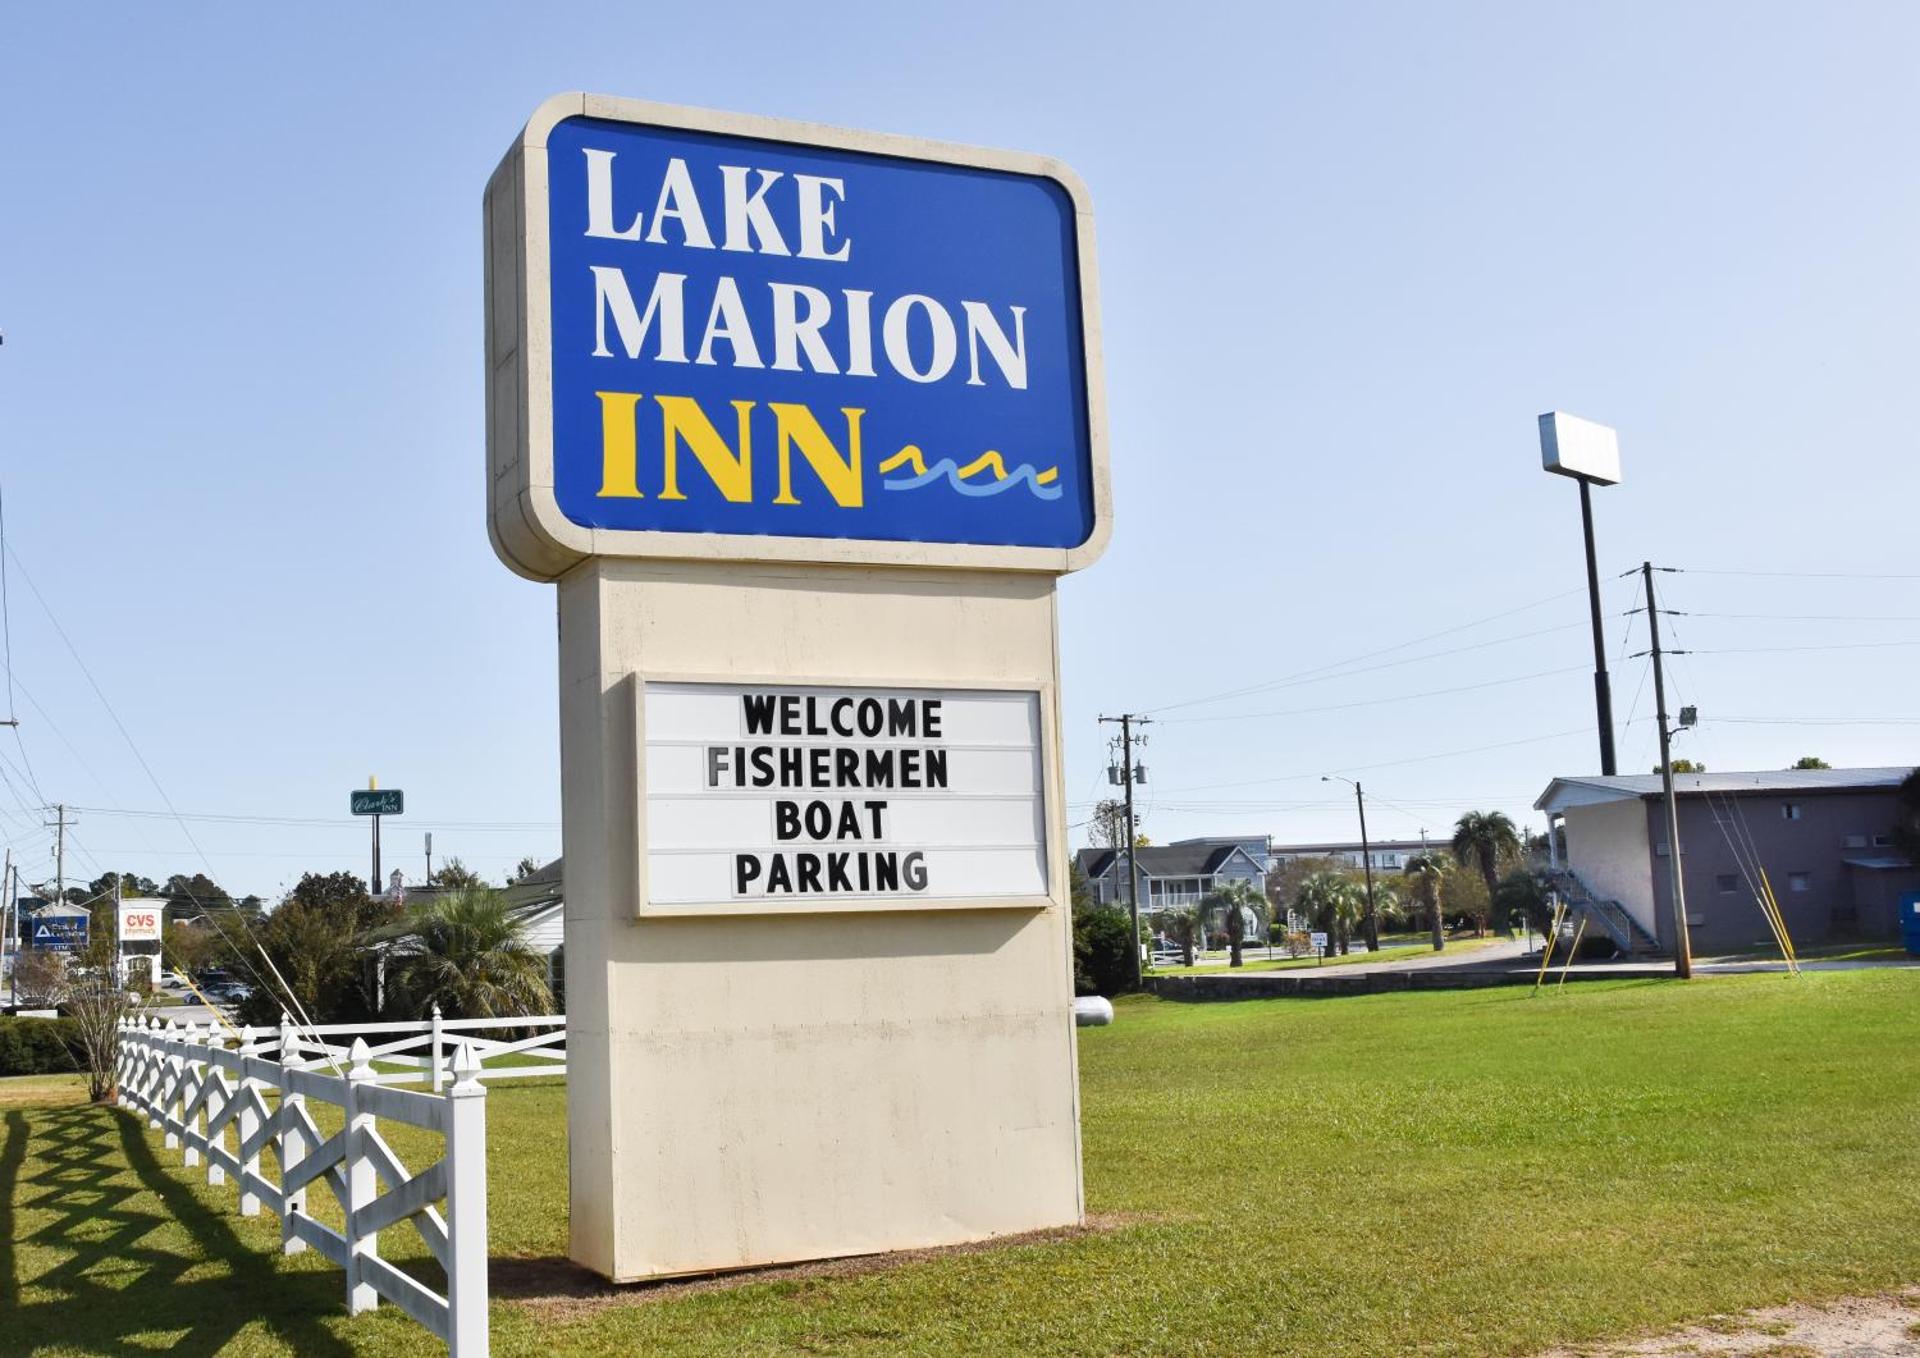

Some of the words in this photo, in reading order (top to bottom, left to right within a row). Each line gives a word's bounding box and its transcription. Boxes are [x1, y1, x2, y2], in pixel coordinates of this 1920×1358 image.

[582, 148, 851, 262] LAKE
[589, 265, 1027, 389] MARION
[595, 391, 866, 508] INN
[743, 694, 942, 738] WELCOME
[708, 746, 947, 788] FISHERMEN
[776, 800, 887, 840] BOAT
[736, 851, 928, 893] PARKING
[127, 915, 154, 927] CVS
